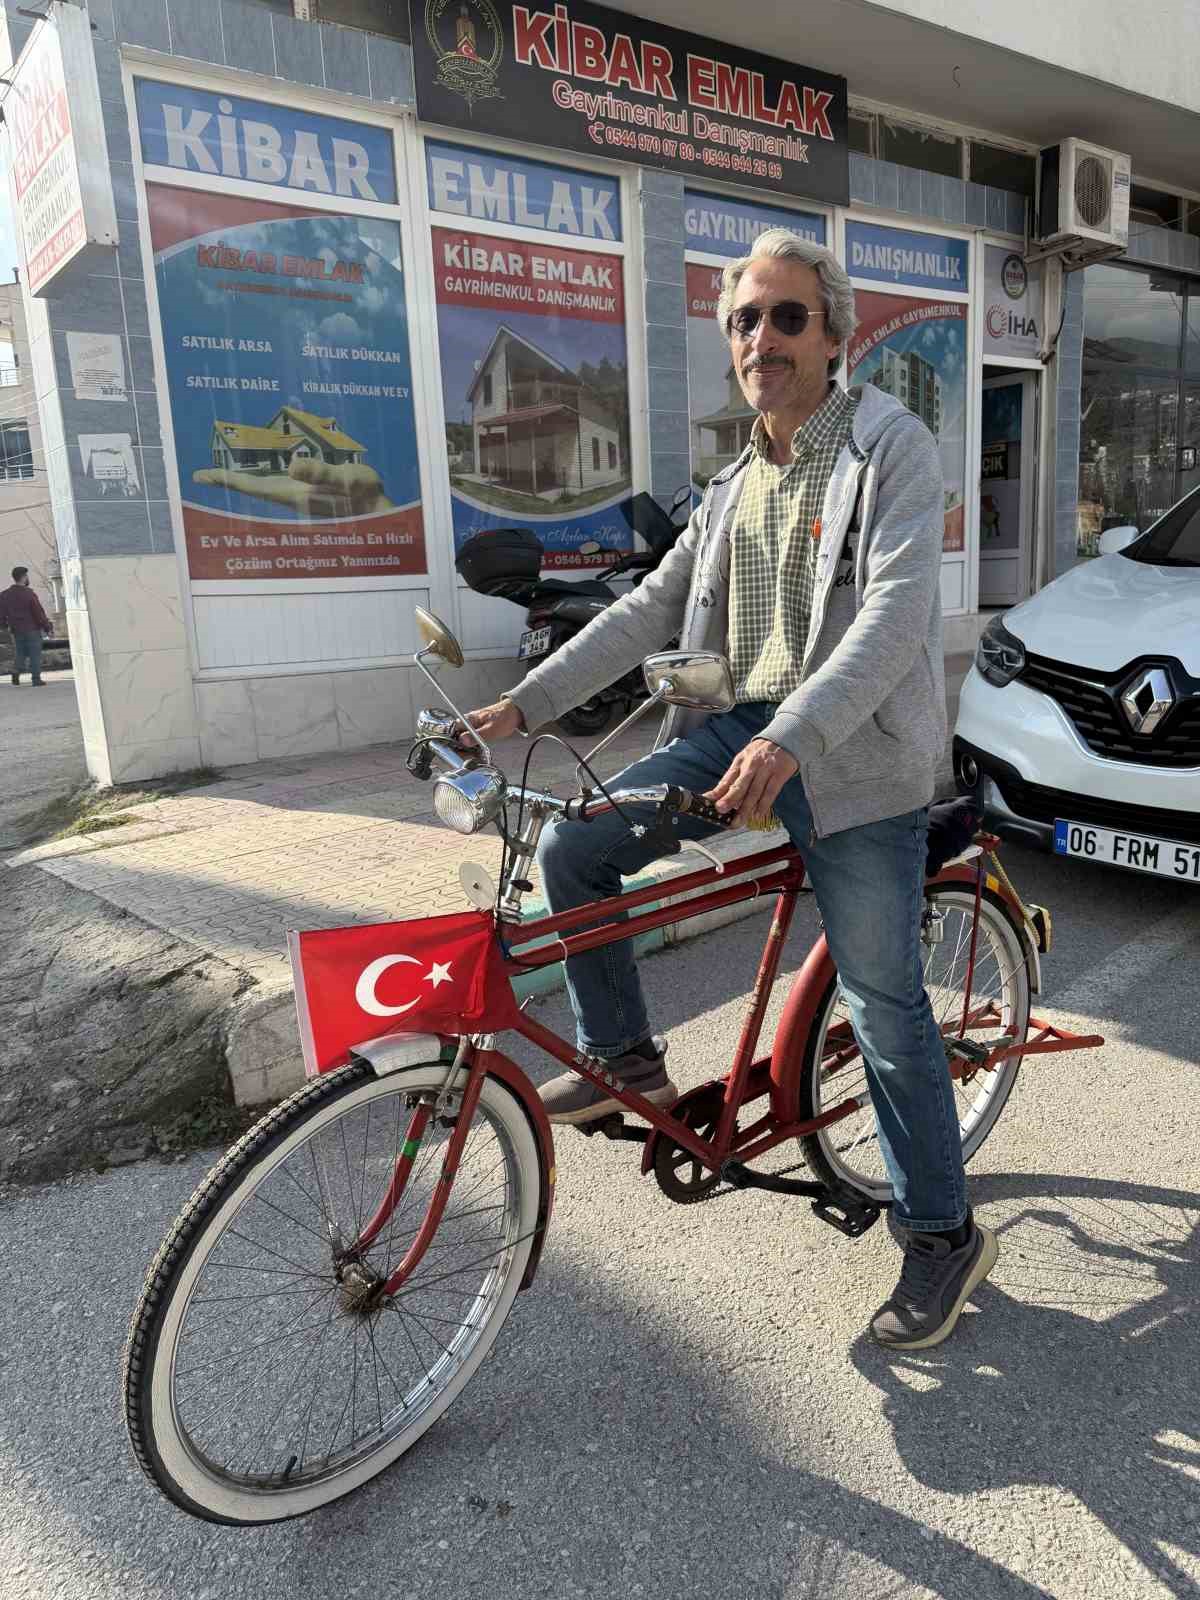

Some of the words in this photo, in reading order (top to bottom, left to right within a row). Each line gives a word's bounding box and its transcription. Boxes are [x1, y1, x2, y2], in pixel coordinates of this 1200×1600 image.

[512, 3, 678, 100] KİBAR
[687, 54, 835, 140] EMLAK
[553, 80, 687, 135] Gayrimenkul
[694, 112, 808, 162] Danışmanlık
[161, 100, 379, 200] KİBAR
[605, 127, 636, 149] 0544
[637, 133, 660, 153] 970
[662, 139, 677, 157] 07
[703, 148, 731, 168] 0544
[430, 156, 617, 240] EMLAK
[283, 255, 366, 284] EMLAK
[443, 239, 525, 277] KİBAR
[531, 256, 614, 289] EMLAK
[852, 241, 961, 280] DANIŞMANLIK
[444, 276, 535, 301] GAYRİMENKUL
[537, 288, 616, 312] DANIŞMANLIK
[1008, 310, 1039, 338] İHA
[182, 335, 234, 350] SATILIK
[238, 339, 273, 353] ARSA
[301, 345, 349, 360] SATILIK
[351, 347, 401, 363] DÜKKAN
[186, 376, 238, 390] SATILIK
[241, 376, 280, 391] DAİRE
[983, 455, 1005, 476] ÇIK
[201, 535, 218, 549] Ev
[223, 535, 241, 547] Ve
[245, 534, 277, 547] Arsa
[280, 533, 310, 546] Alım
[313, 533, 364, 546] Satımda
[367, 533, 384, 545] En
[386, 533, 413, 545] Hızlı
[225, 556, 272, 574] Çözüm
[1056, 838, 1066, 847] TR
[1070, 827, 1097, 855] 06
[1113, 835, 1160, 869] FRM
[1174, 847, 1200, 877] 51
